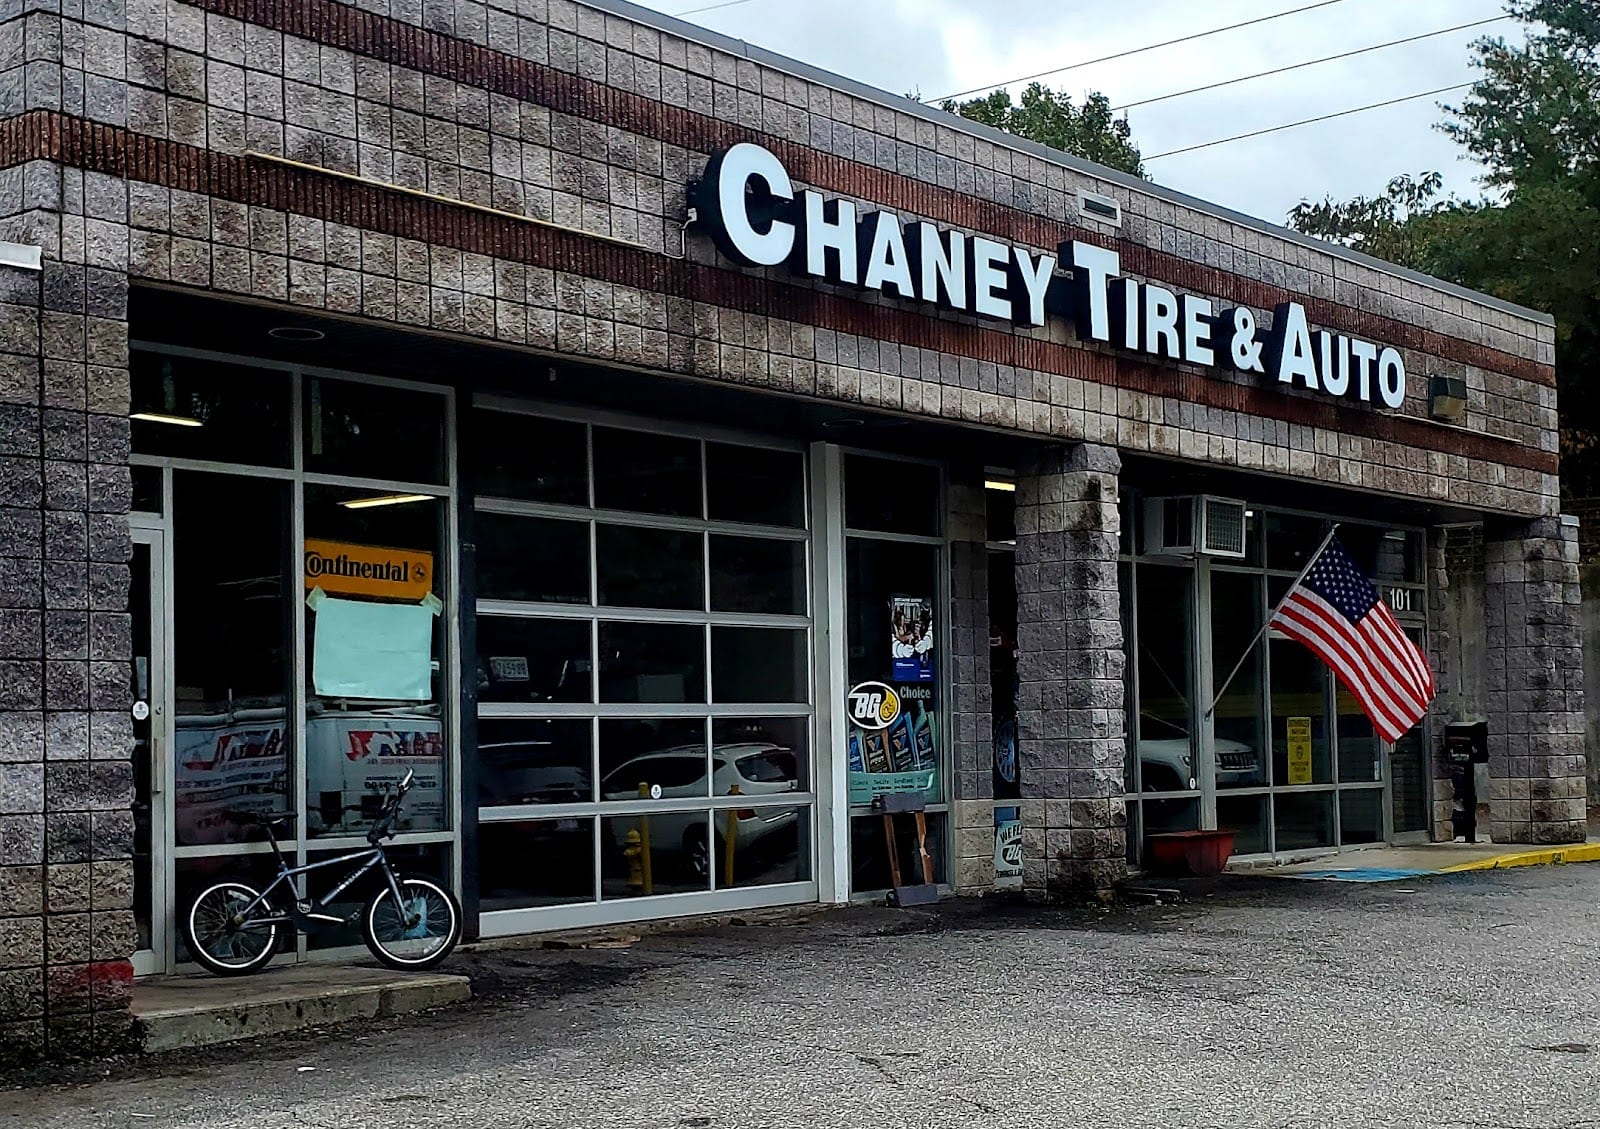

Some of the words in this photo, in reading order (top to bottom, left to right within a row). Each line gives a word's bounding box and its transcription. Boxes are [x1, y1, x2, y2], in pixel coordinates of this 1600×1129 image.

[717, 142, 1056, 327] CHANEY
[1073, 240, 1215, 367] TIRE
[1231, 306, 1265, 374] &
[1278, 300, 1406, 409] AUTO
[304, 550, 410, 583] Continental
[1389, 587, 1412, 612] 101
[853, 692, 883, 720] BG
[899, 685, 932, 699] Choice
